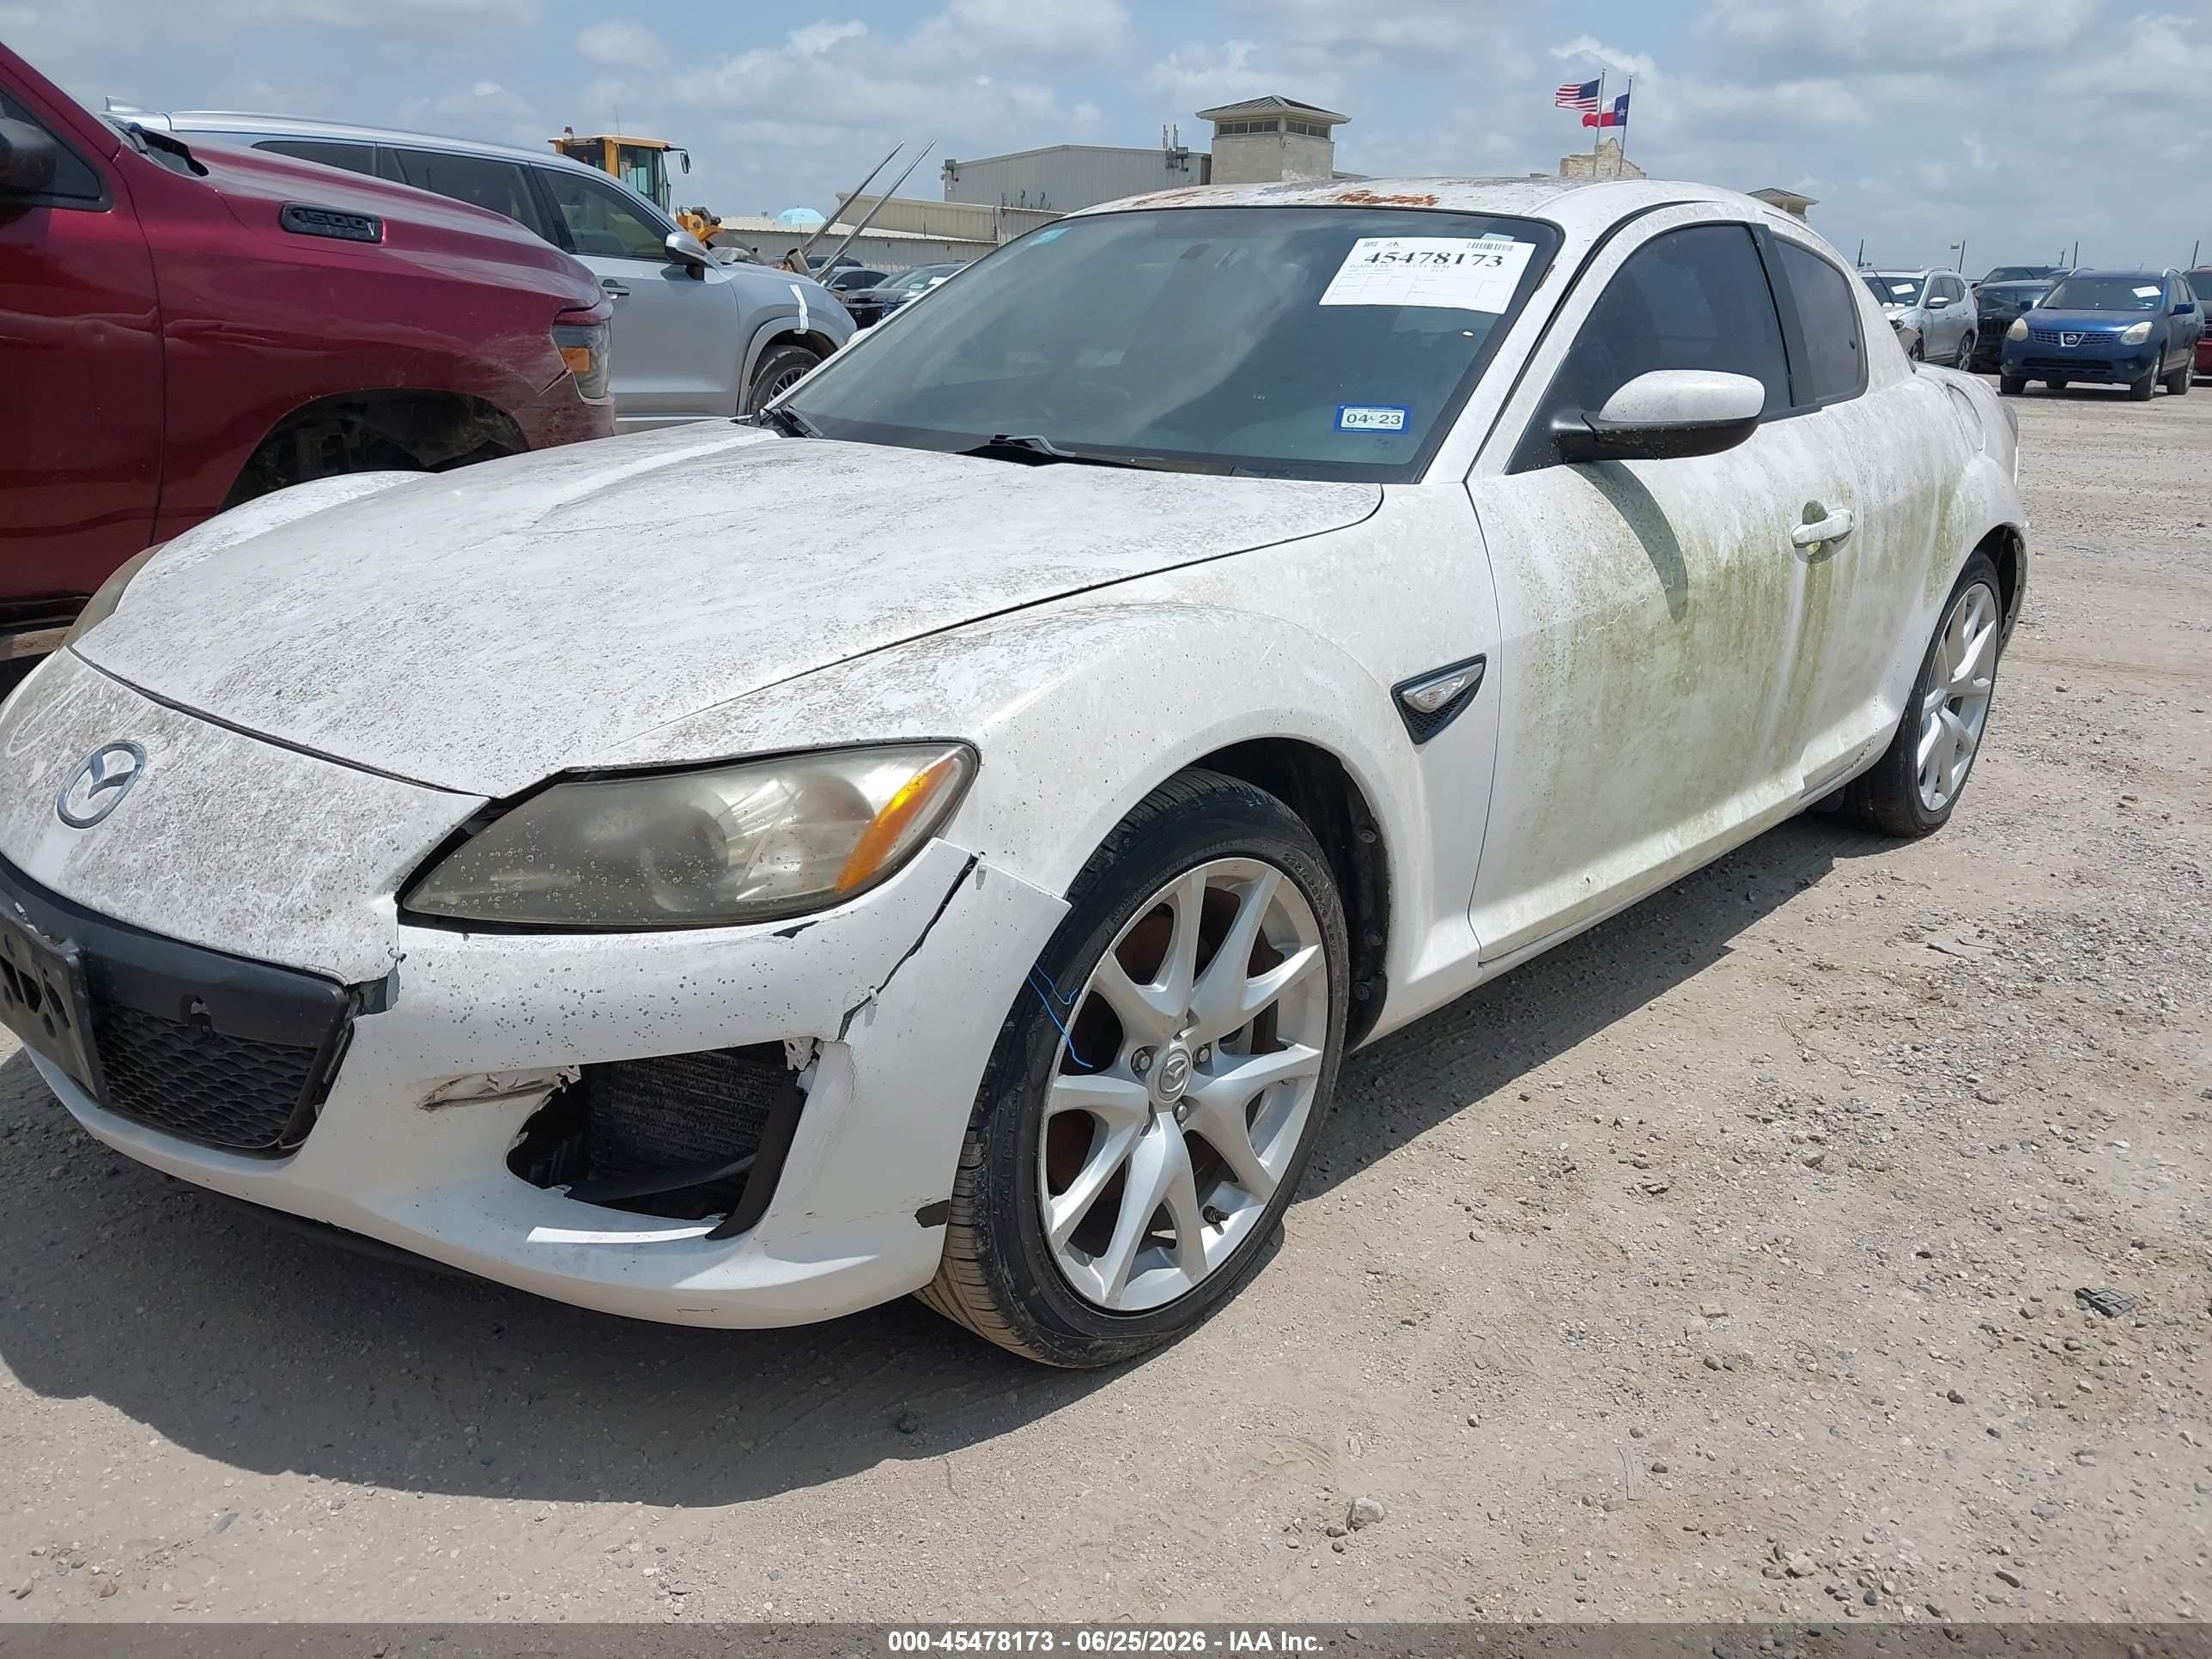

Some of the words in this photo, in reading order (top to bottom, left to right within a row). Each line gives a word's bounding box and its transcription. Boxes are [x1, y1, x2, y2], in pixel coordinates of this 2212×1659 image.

[291, 207, 370, 230] 1500
[1364, 251, 1504, 268] 45478173
[1346, 414, 1368, 423] 04
[1378, 414, 1401, 425] 23
